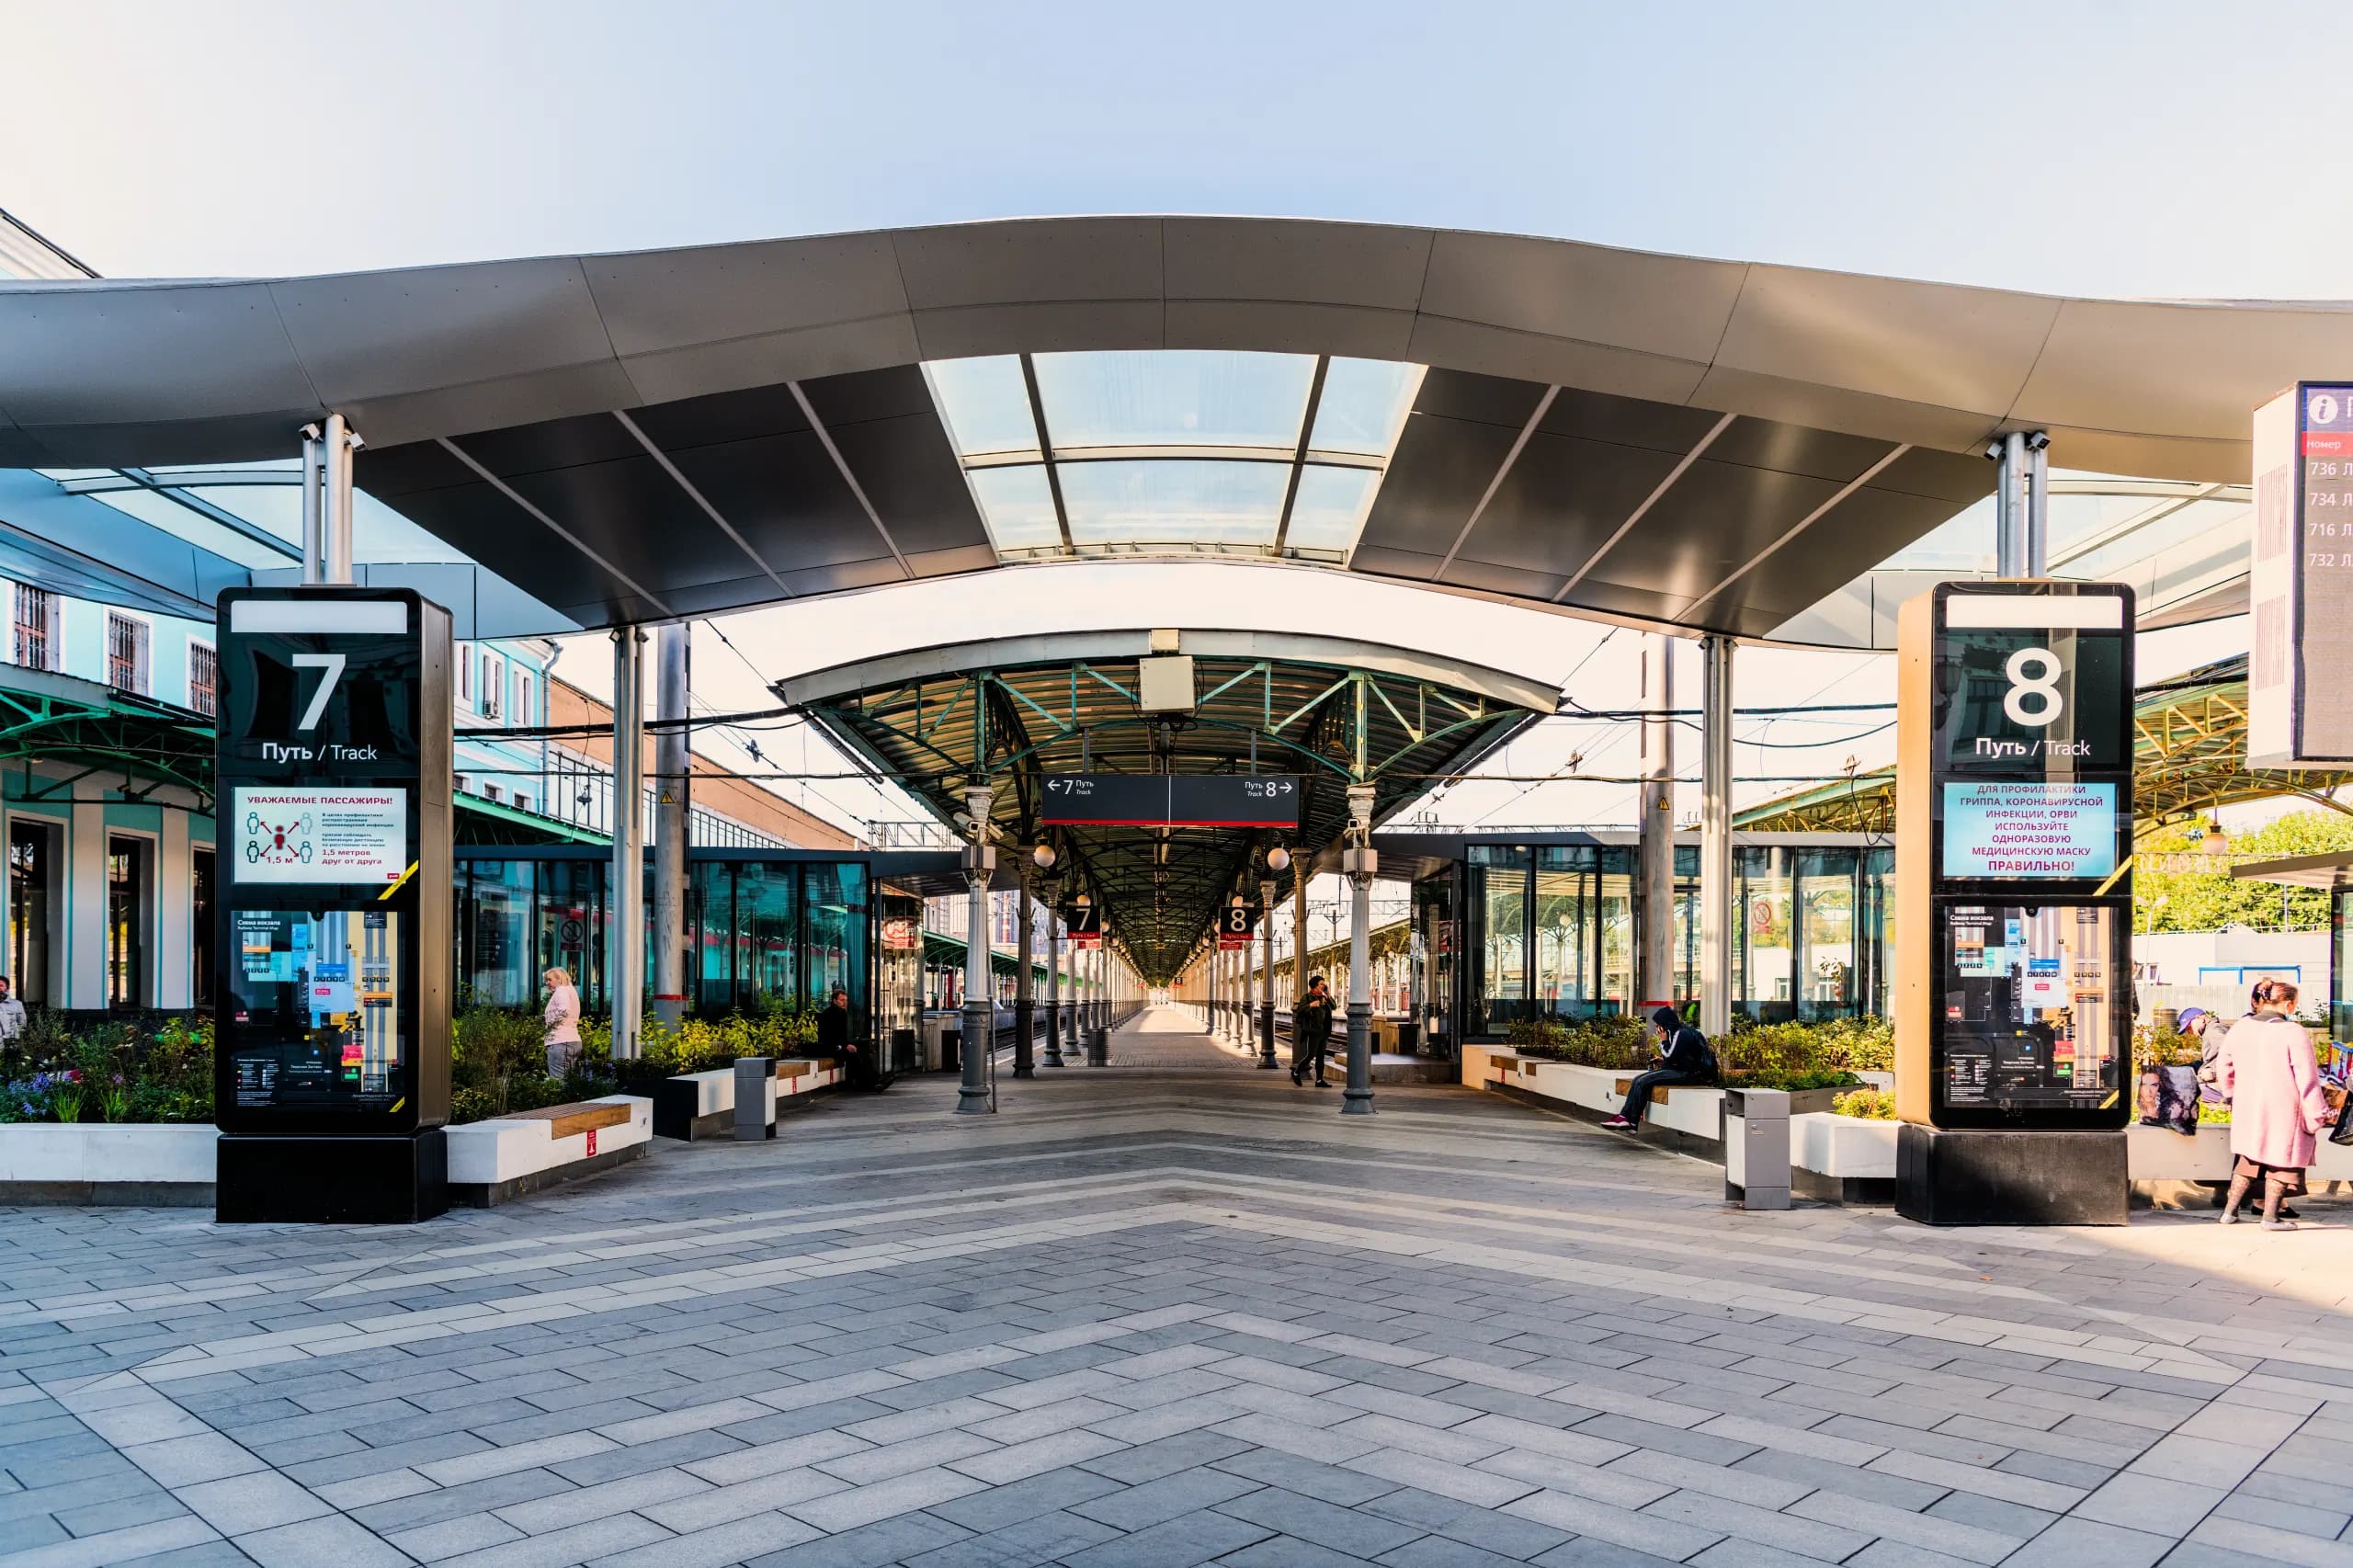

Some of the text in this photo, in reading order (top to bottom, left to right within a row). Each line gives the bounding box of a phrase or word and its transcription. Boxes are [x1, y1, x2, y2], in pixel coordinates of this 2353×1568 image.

[2310, 462, 2336, 476] 736
[2310, 493, 2336, 506] 734
[2309, 523, 2336, 536] 716
[2308, 553, 2335, 567] 732
[291, 653, 347, 731] 7
[2004, 647, 2063, 727] 8
[262, 743, 313, 764] Путь
[330, 744, 378, 760] Track
[1976, 738, 2027, 759] Путь
[2043, 740, 2091, 756] Track
[1063, 779, 1074, 795] 7
[1075, 779, 1095, 789] Путь
[1245, 781, 1263, 790] Путь
[1266, 781, 1277, 798] 8
[1977, 785, 2086, 794] ДЛЯ ПРОФИЛАКТИКИ
[247, 796, 393, 805] УВАЖАЕМЫЕ ПАССАЖИРЫ!
[1961, 797, 2103, 807] ГРИППА, КОРОНАВИРУСНОЙ
[1985, 810, 2077, 820] ИНФЕКЦИИ, ОРВИ
[1995, 822, 2069, 831] ИСПОЛЬЗУЙТЕ
[1992, 835, 2072, 845] ОДНОРАЗОВУЮ
[337, 849, 371, 858] метров
[1972, 847, 2092, 858] МЕДИЦИНСКУЮ МАСКУ
[1988, 861, 2075, 872] ПРАВИЛЬНО!
[1075, 908, 1090, 931] 7
[1230, 909, 1246, 932] 8
